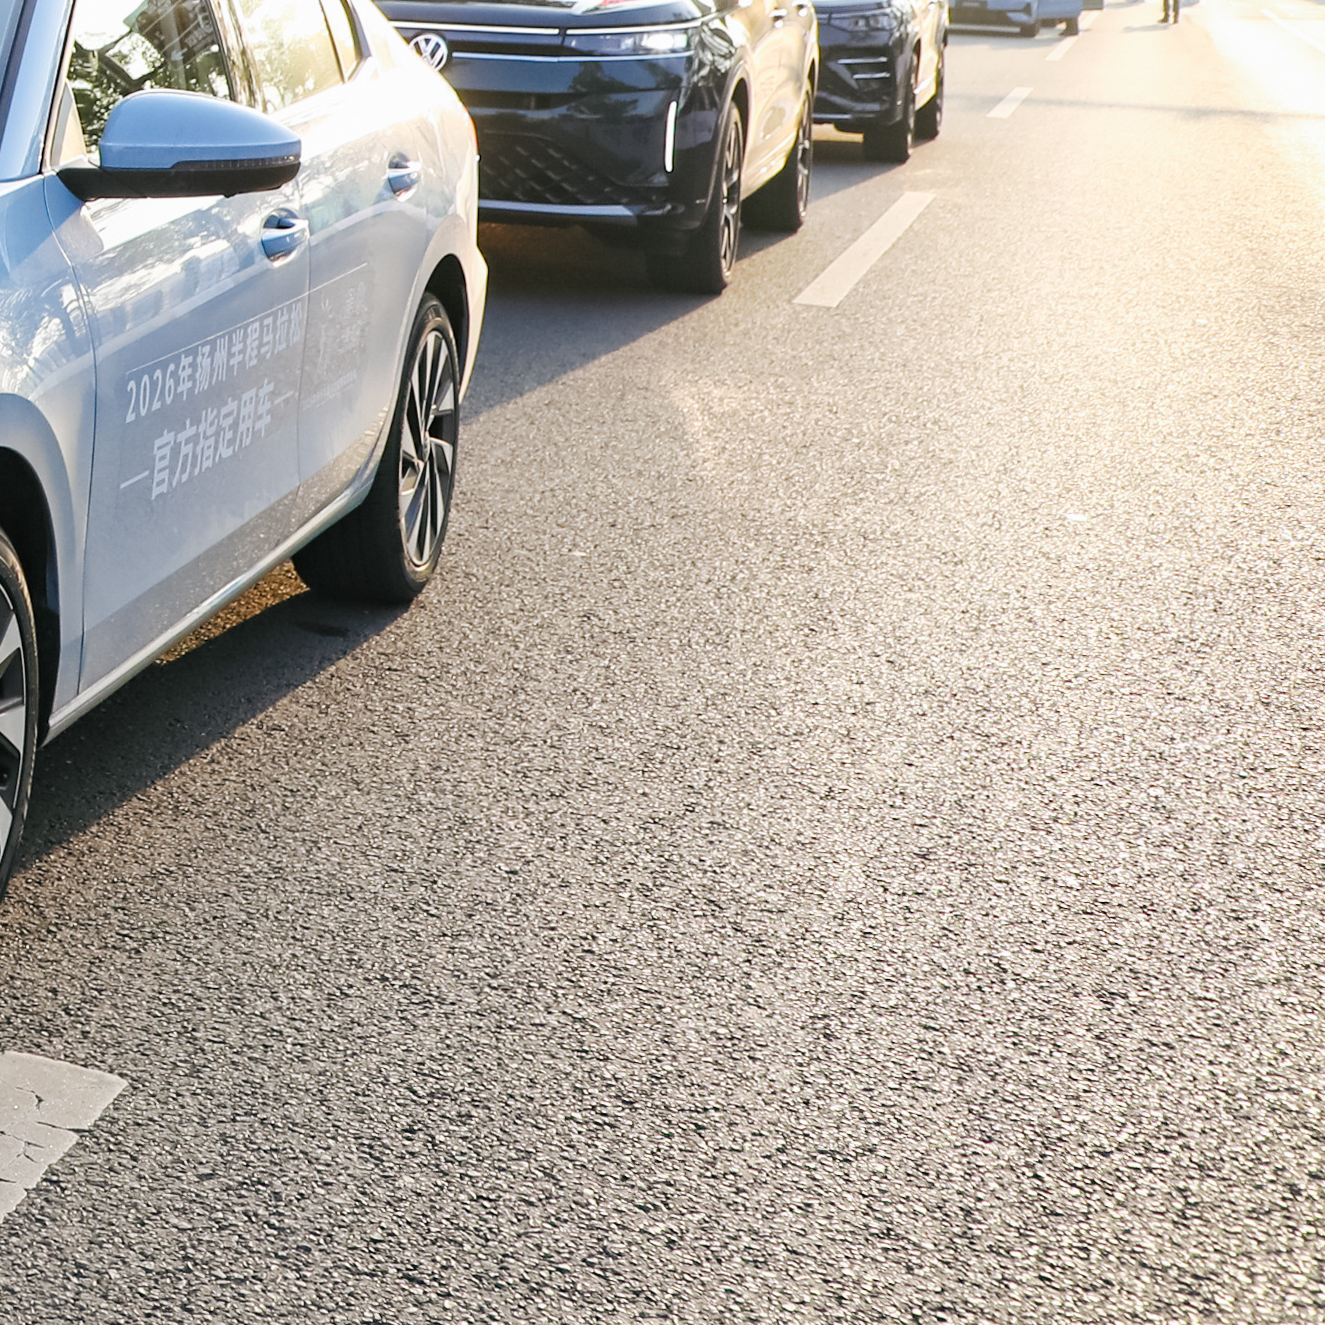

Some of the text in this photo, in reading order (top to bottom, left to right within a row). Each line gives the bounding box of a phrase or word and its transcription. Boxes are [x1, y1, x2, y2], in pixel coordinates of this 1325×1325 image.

[125, 302, 302, 424] 2026年扬州半程马拉松
